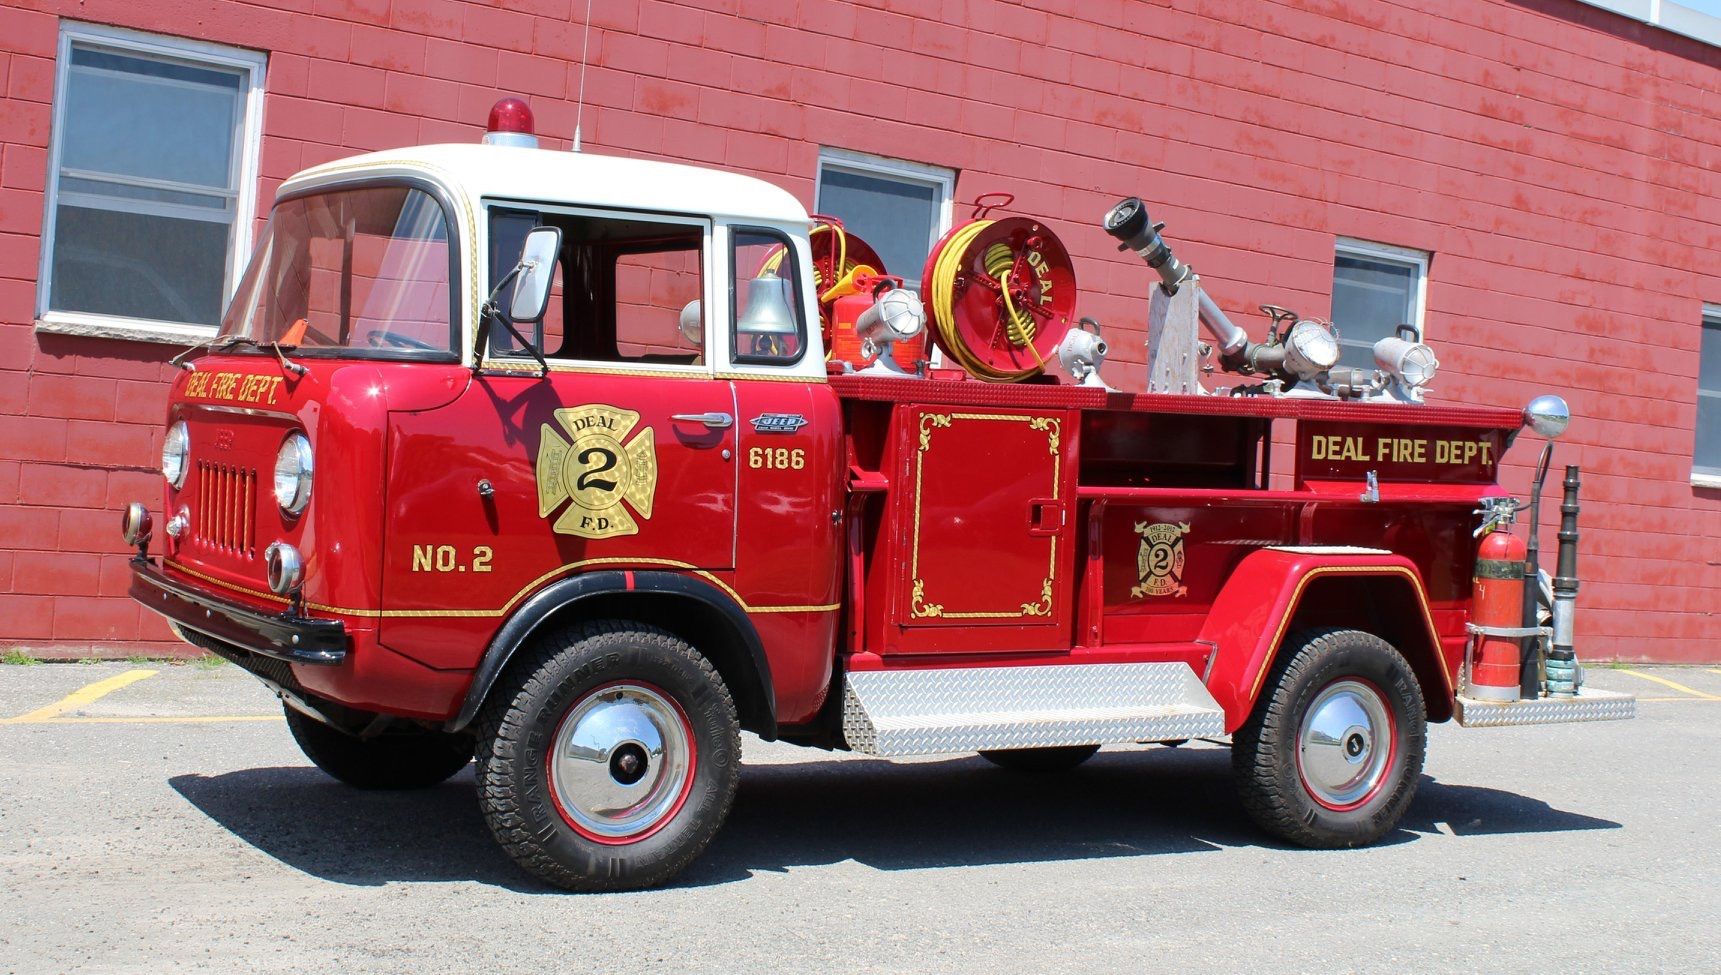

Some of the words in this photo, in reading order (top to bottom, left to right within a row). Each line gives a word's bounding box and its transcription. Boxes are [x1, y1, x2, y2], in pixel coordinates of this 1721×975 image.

[1027, 251, 1053, 305] DEAL
[184, 372, 212, 397] DEAL
[208, 373, 242, 400] FIRE
[238, 374, 284, 404] DEPT.
[573, 415, 618, 432] DEAL
[749, 447, 805, 470] 6186
[1312, 435, 1370, 462] DEAL
[1377, 438, 1428, 463] FIRE
[1435, 440, 1493, 465] DEPT.
[577, 447, 617, 491] 2
[580, 516, 614, 531] F.D.
[1151, 533, 1172, 543] DEAL
[412, 545, 466, 572] NO.
[473, 545, 493, 572] 2
[1154, 548, 1168, 570] 2
[535, 652, 623, 724] RUNNER
[523, 730, 548, 824] RANGE
